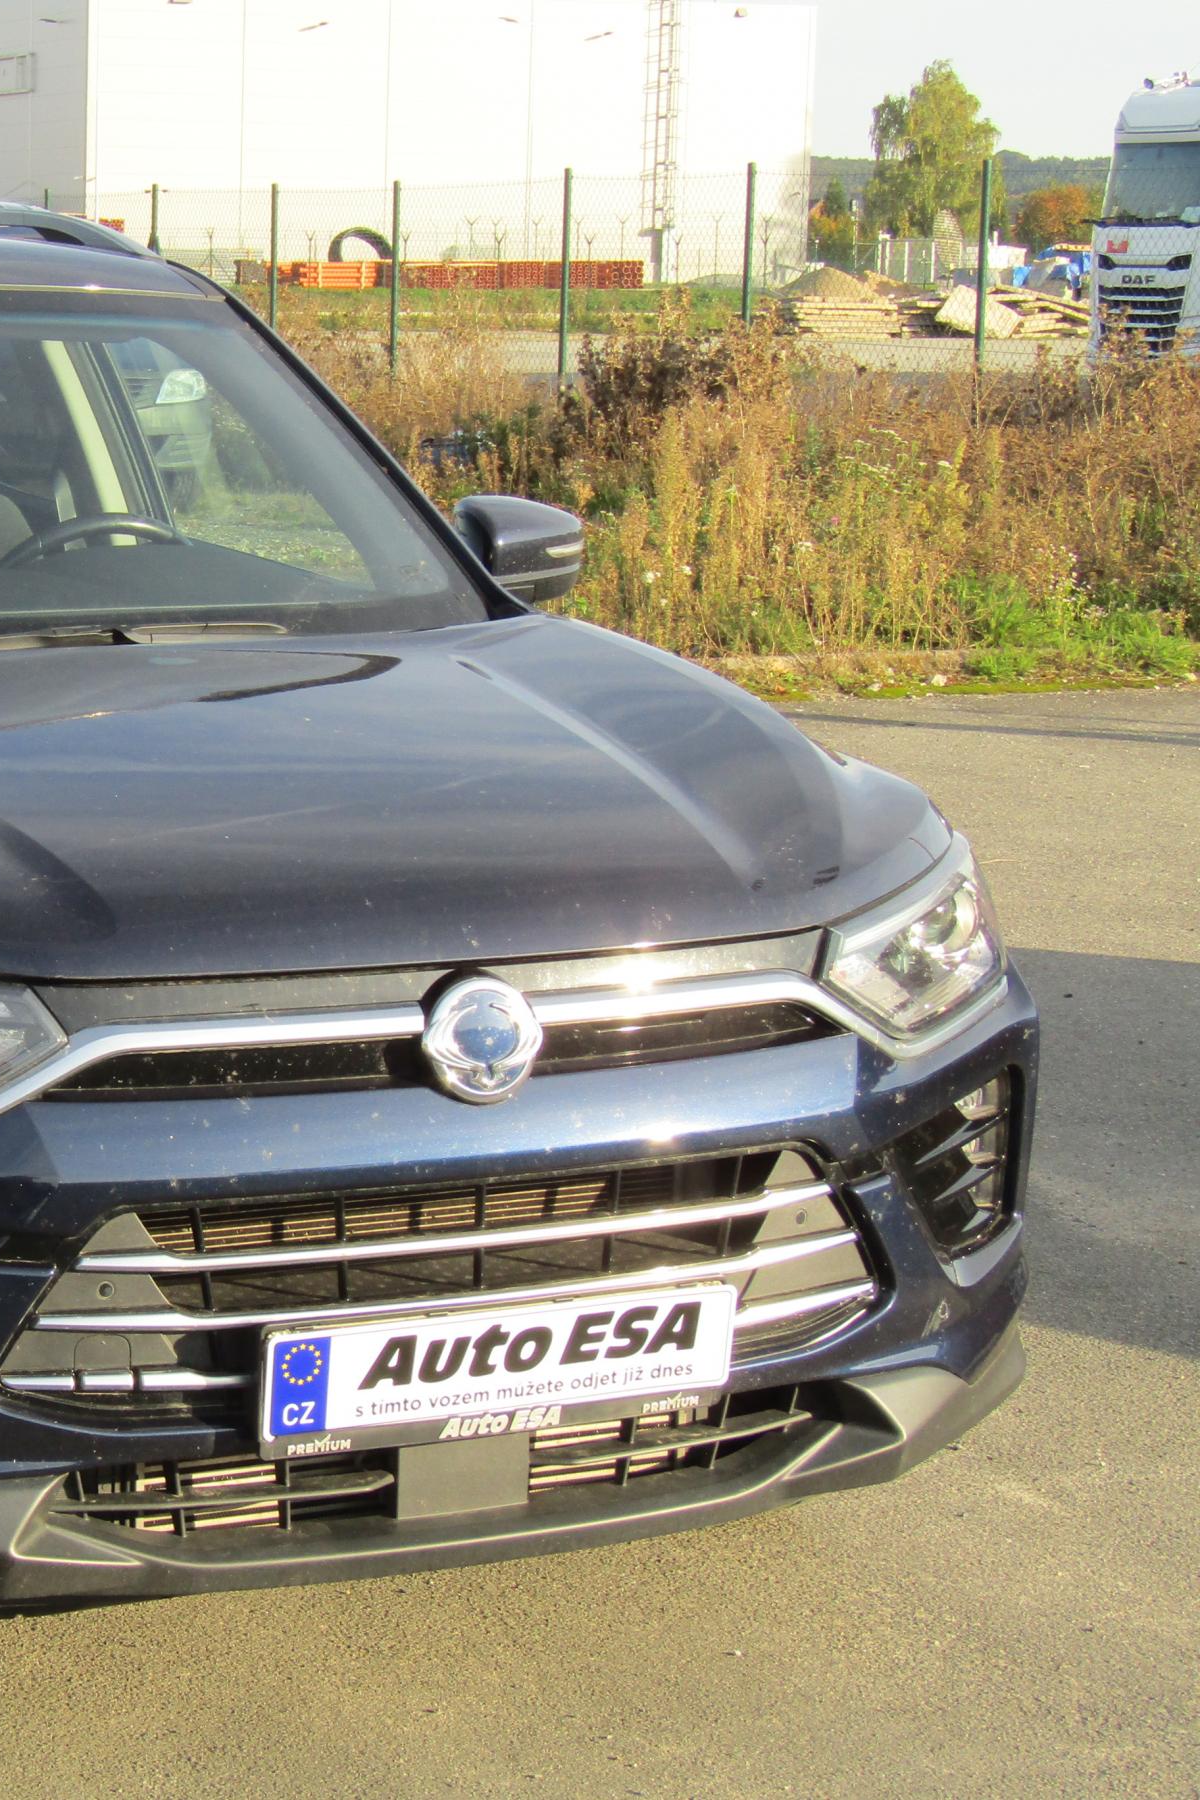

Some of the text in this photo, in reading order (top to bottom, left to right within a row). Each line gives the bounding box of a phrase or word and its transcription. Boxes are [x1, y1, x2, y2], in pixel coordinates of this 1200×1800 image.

[1121, 275, 1155, 284] DAF
[357, 1301, 701, 1390] Auto ESA
[356, 1406, 363, 1417] s
[429, 1391, 489, 1408] vozem
[571, 1372, 616, 1389] odjet
[623, 1366, 643, 1385] již
[650, 1364, 693, 1379] dnes
[642, 1392, 699, 1413] PREMIUM
[282, 1401, 315, 1426] CZ
[439, 1405, 561, 1439] Auto ESA
[288, 1433, 351, 1455] PREMIUM
